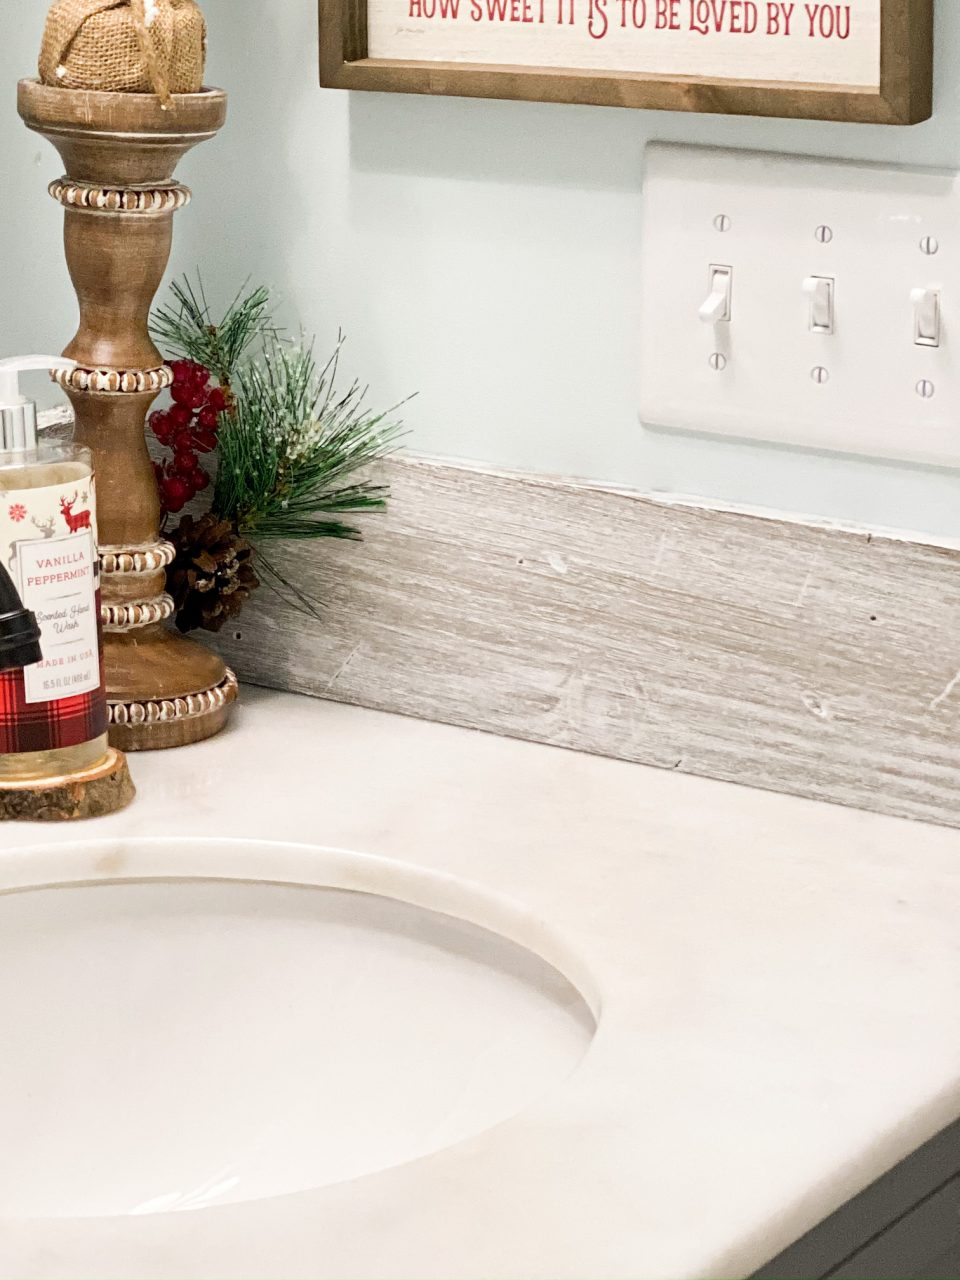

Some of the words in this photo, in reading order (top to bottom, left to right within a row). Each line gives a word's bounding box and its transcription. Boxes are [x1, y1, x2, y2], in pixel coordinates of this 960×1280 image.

[766, 2, 795, 36] BY
[804, 3, 851, 40] YOU
[36, 551, 85, 569] VANILLA
[27, 565, 90, 587] PEPPERMINT
